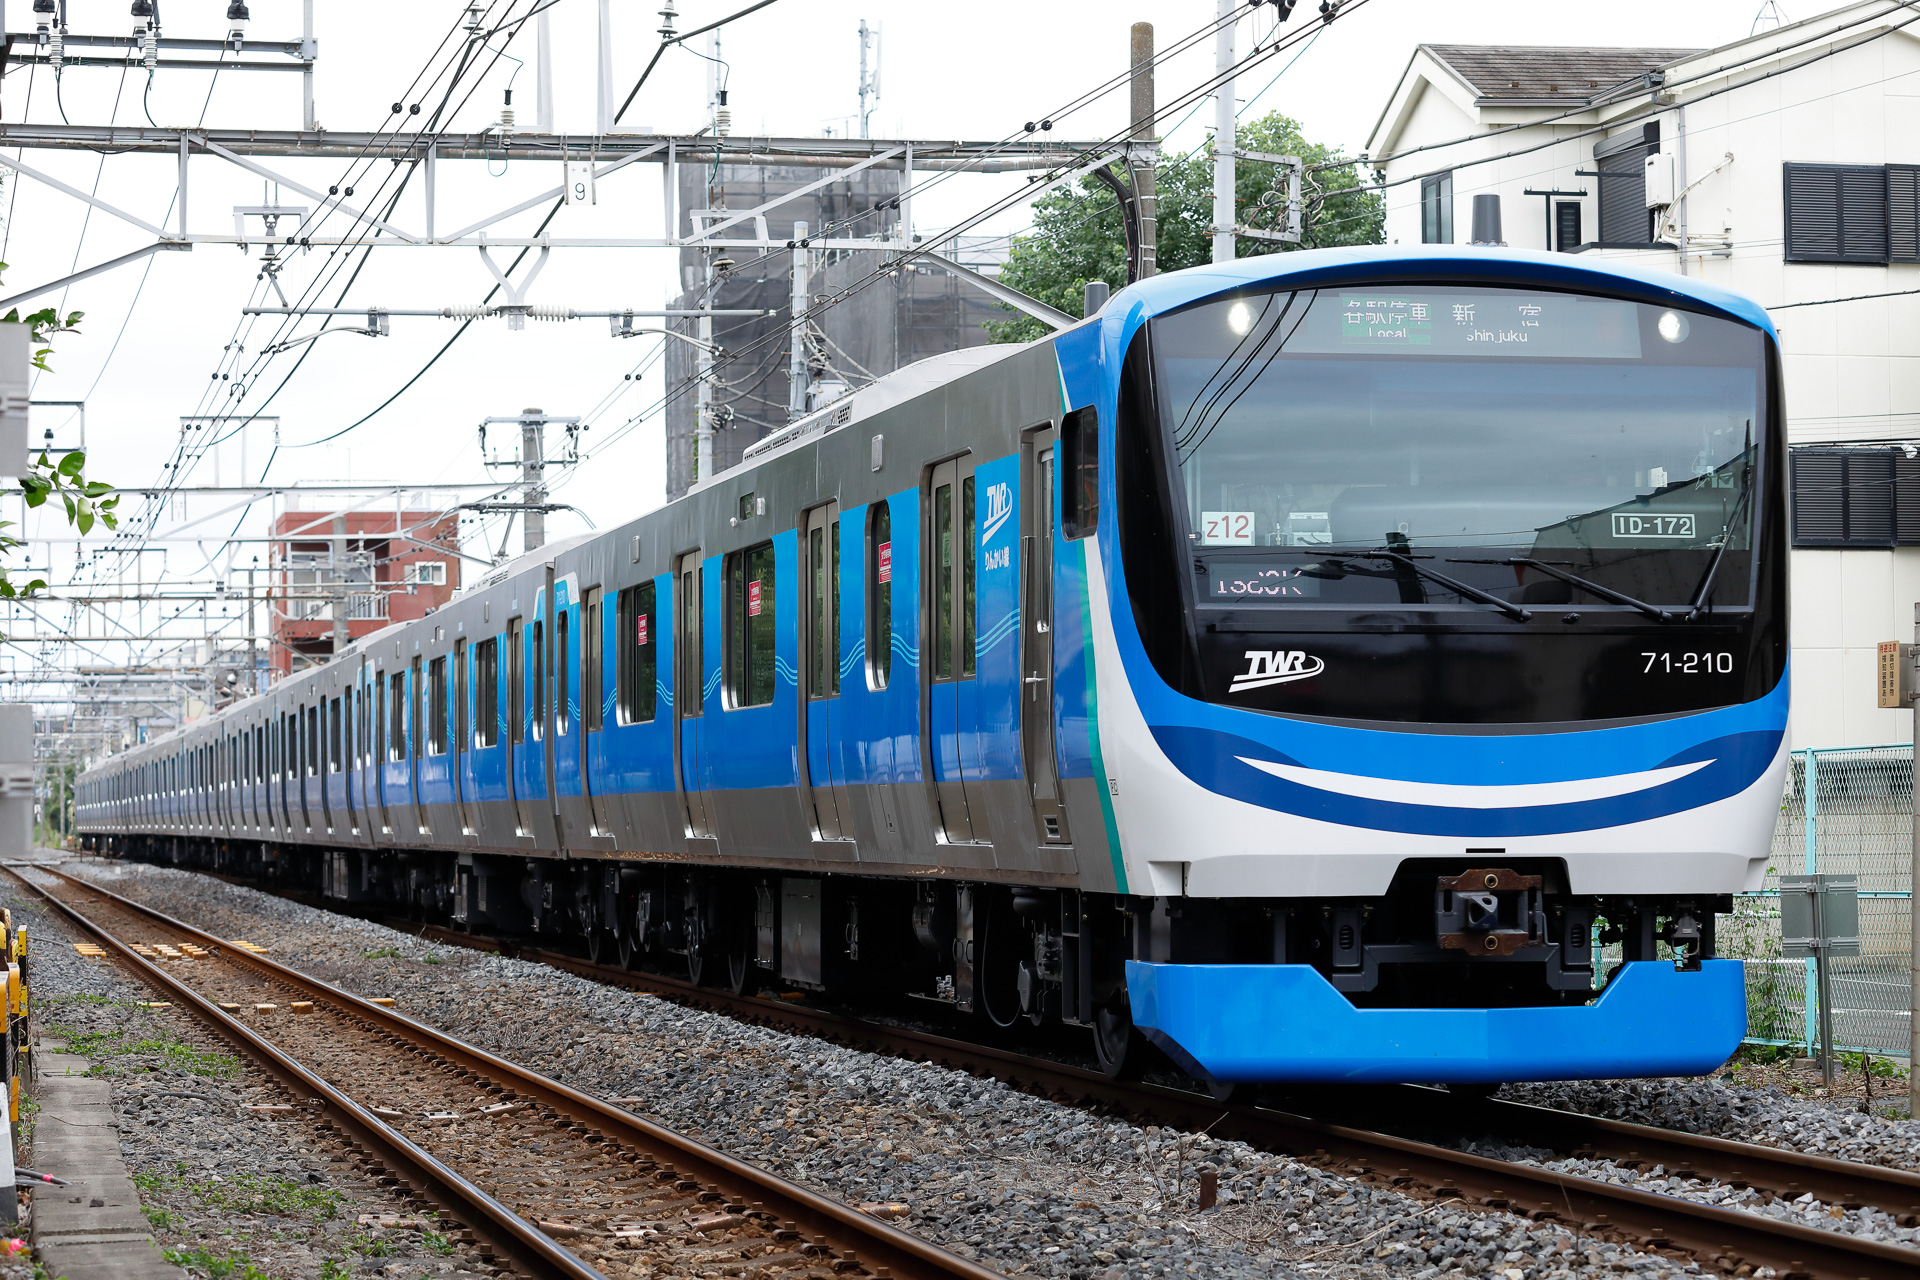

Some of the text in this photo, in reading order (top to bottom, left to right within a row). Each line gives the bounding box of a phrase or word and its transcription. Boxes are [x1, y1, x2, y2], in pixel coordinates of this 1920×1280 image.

[575, 182, 586, 201] 9
[1619, 516, 1692, 535] ID-172
[984, 545, 1010, 572] りんかい線
[1640, 652, 1733, 673] 71-210
